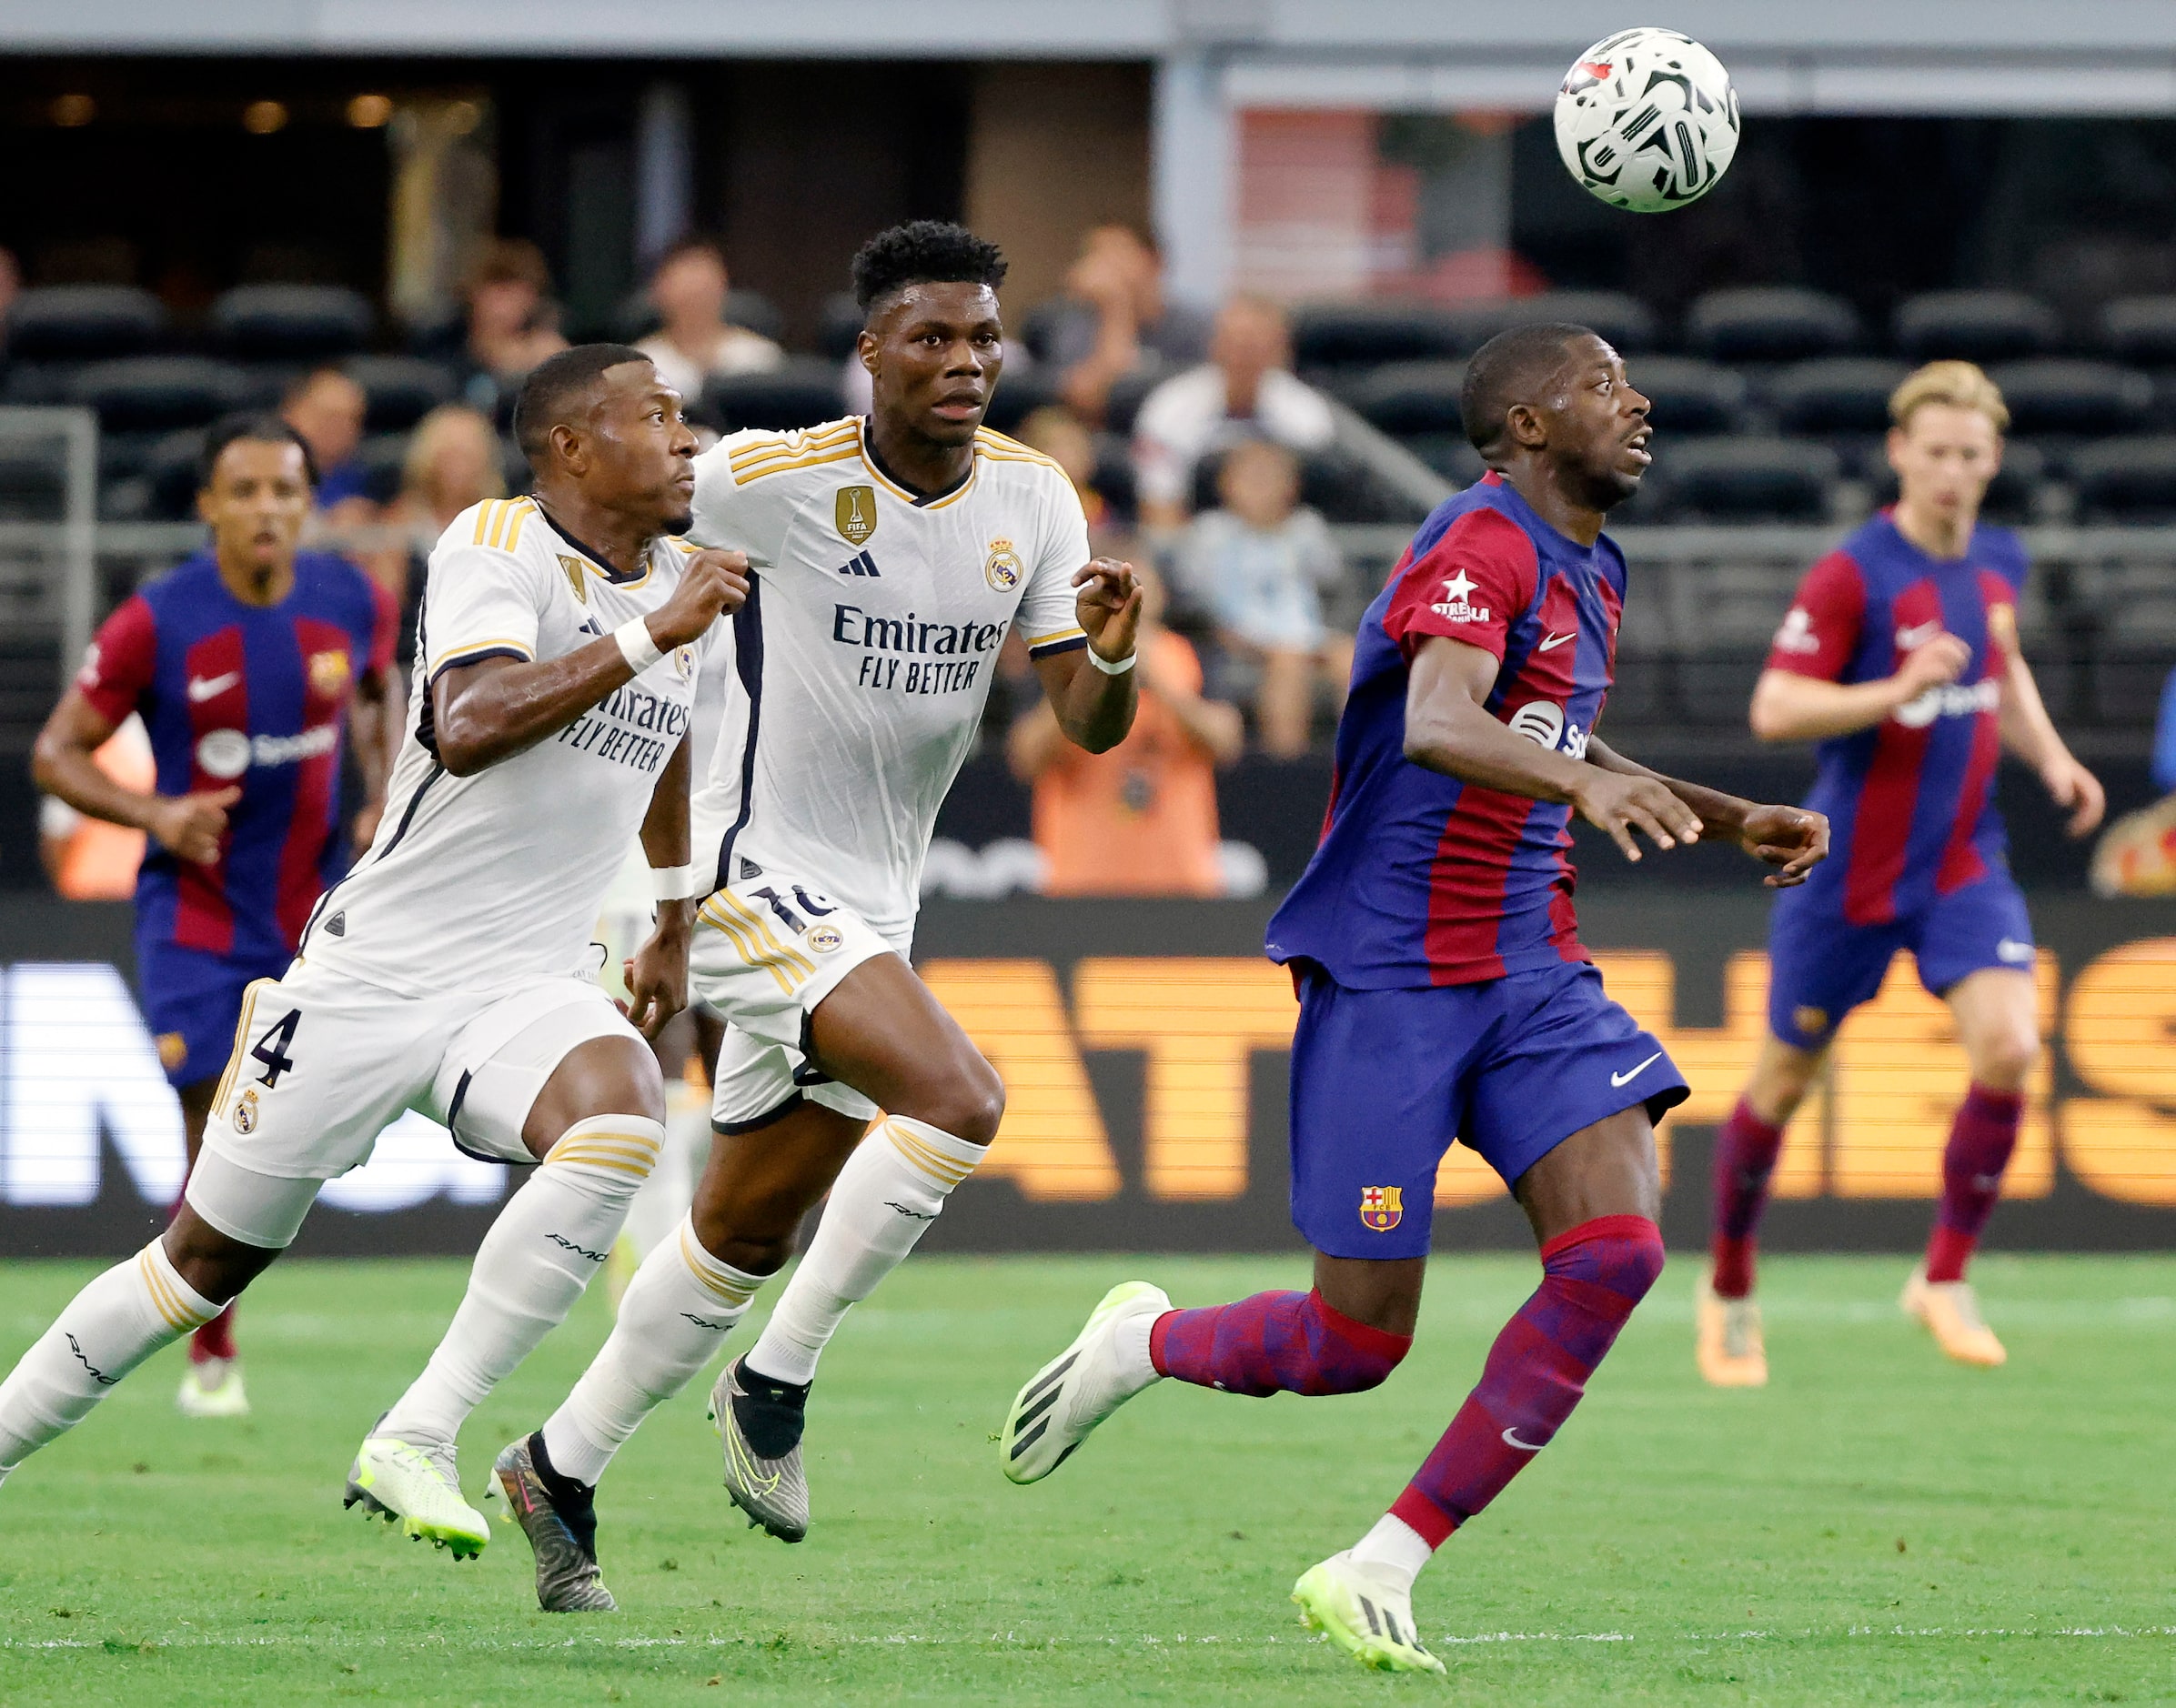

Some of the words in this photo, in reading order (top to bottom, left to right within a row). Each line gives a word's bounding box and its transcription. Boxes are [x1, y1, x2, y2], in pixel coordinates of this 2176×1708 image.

[847, 522, 867, 531] FIFA
[833, 603, 1007, 655] Emirates
[859, 656, 900, 690] FLY
[906, 660, 979, 695] BETTER
[558, 716, 607, 751] FLY
[598, 727, 666, 773] BETTER
[250, 1008, 302, 1090] 4
